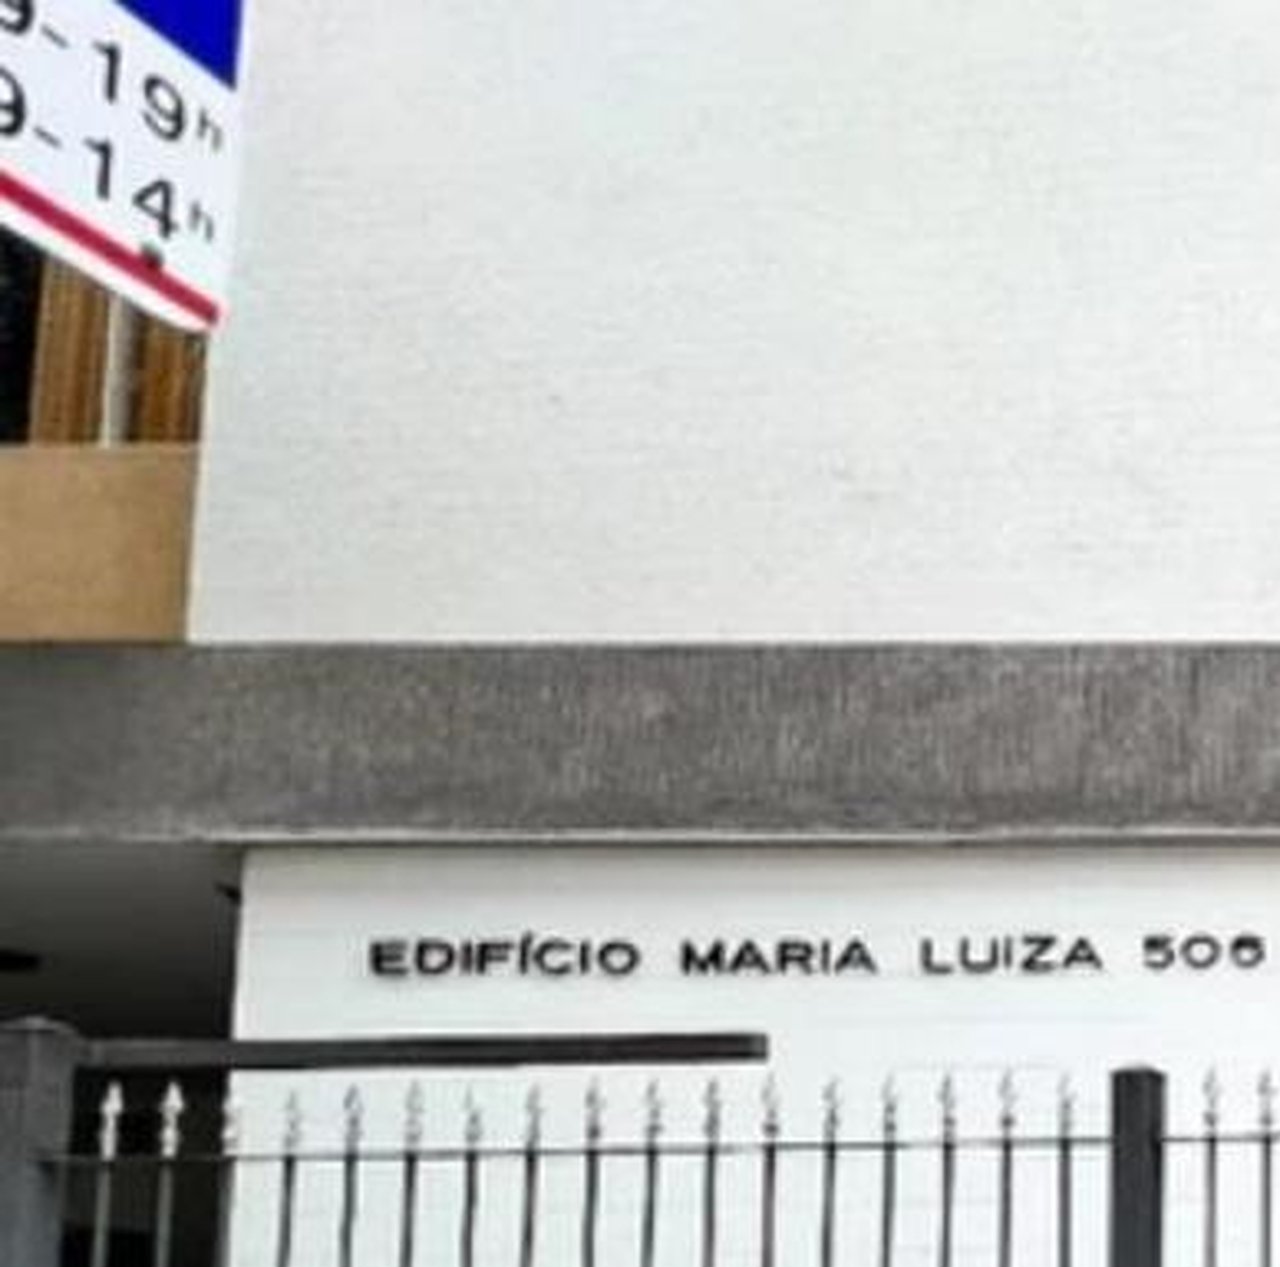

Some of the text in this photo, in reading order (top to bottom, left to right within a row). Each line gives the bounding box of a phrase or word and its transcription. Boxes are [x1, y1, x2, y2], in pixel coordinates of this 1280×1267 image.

[368, 930, 641, 979] EDIFÍCIO
[679, 936, 877, 977] MARIA
[920, 934, 1103, 974] LUIZA
